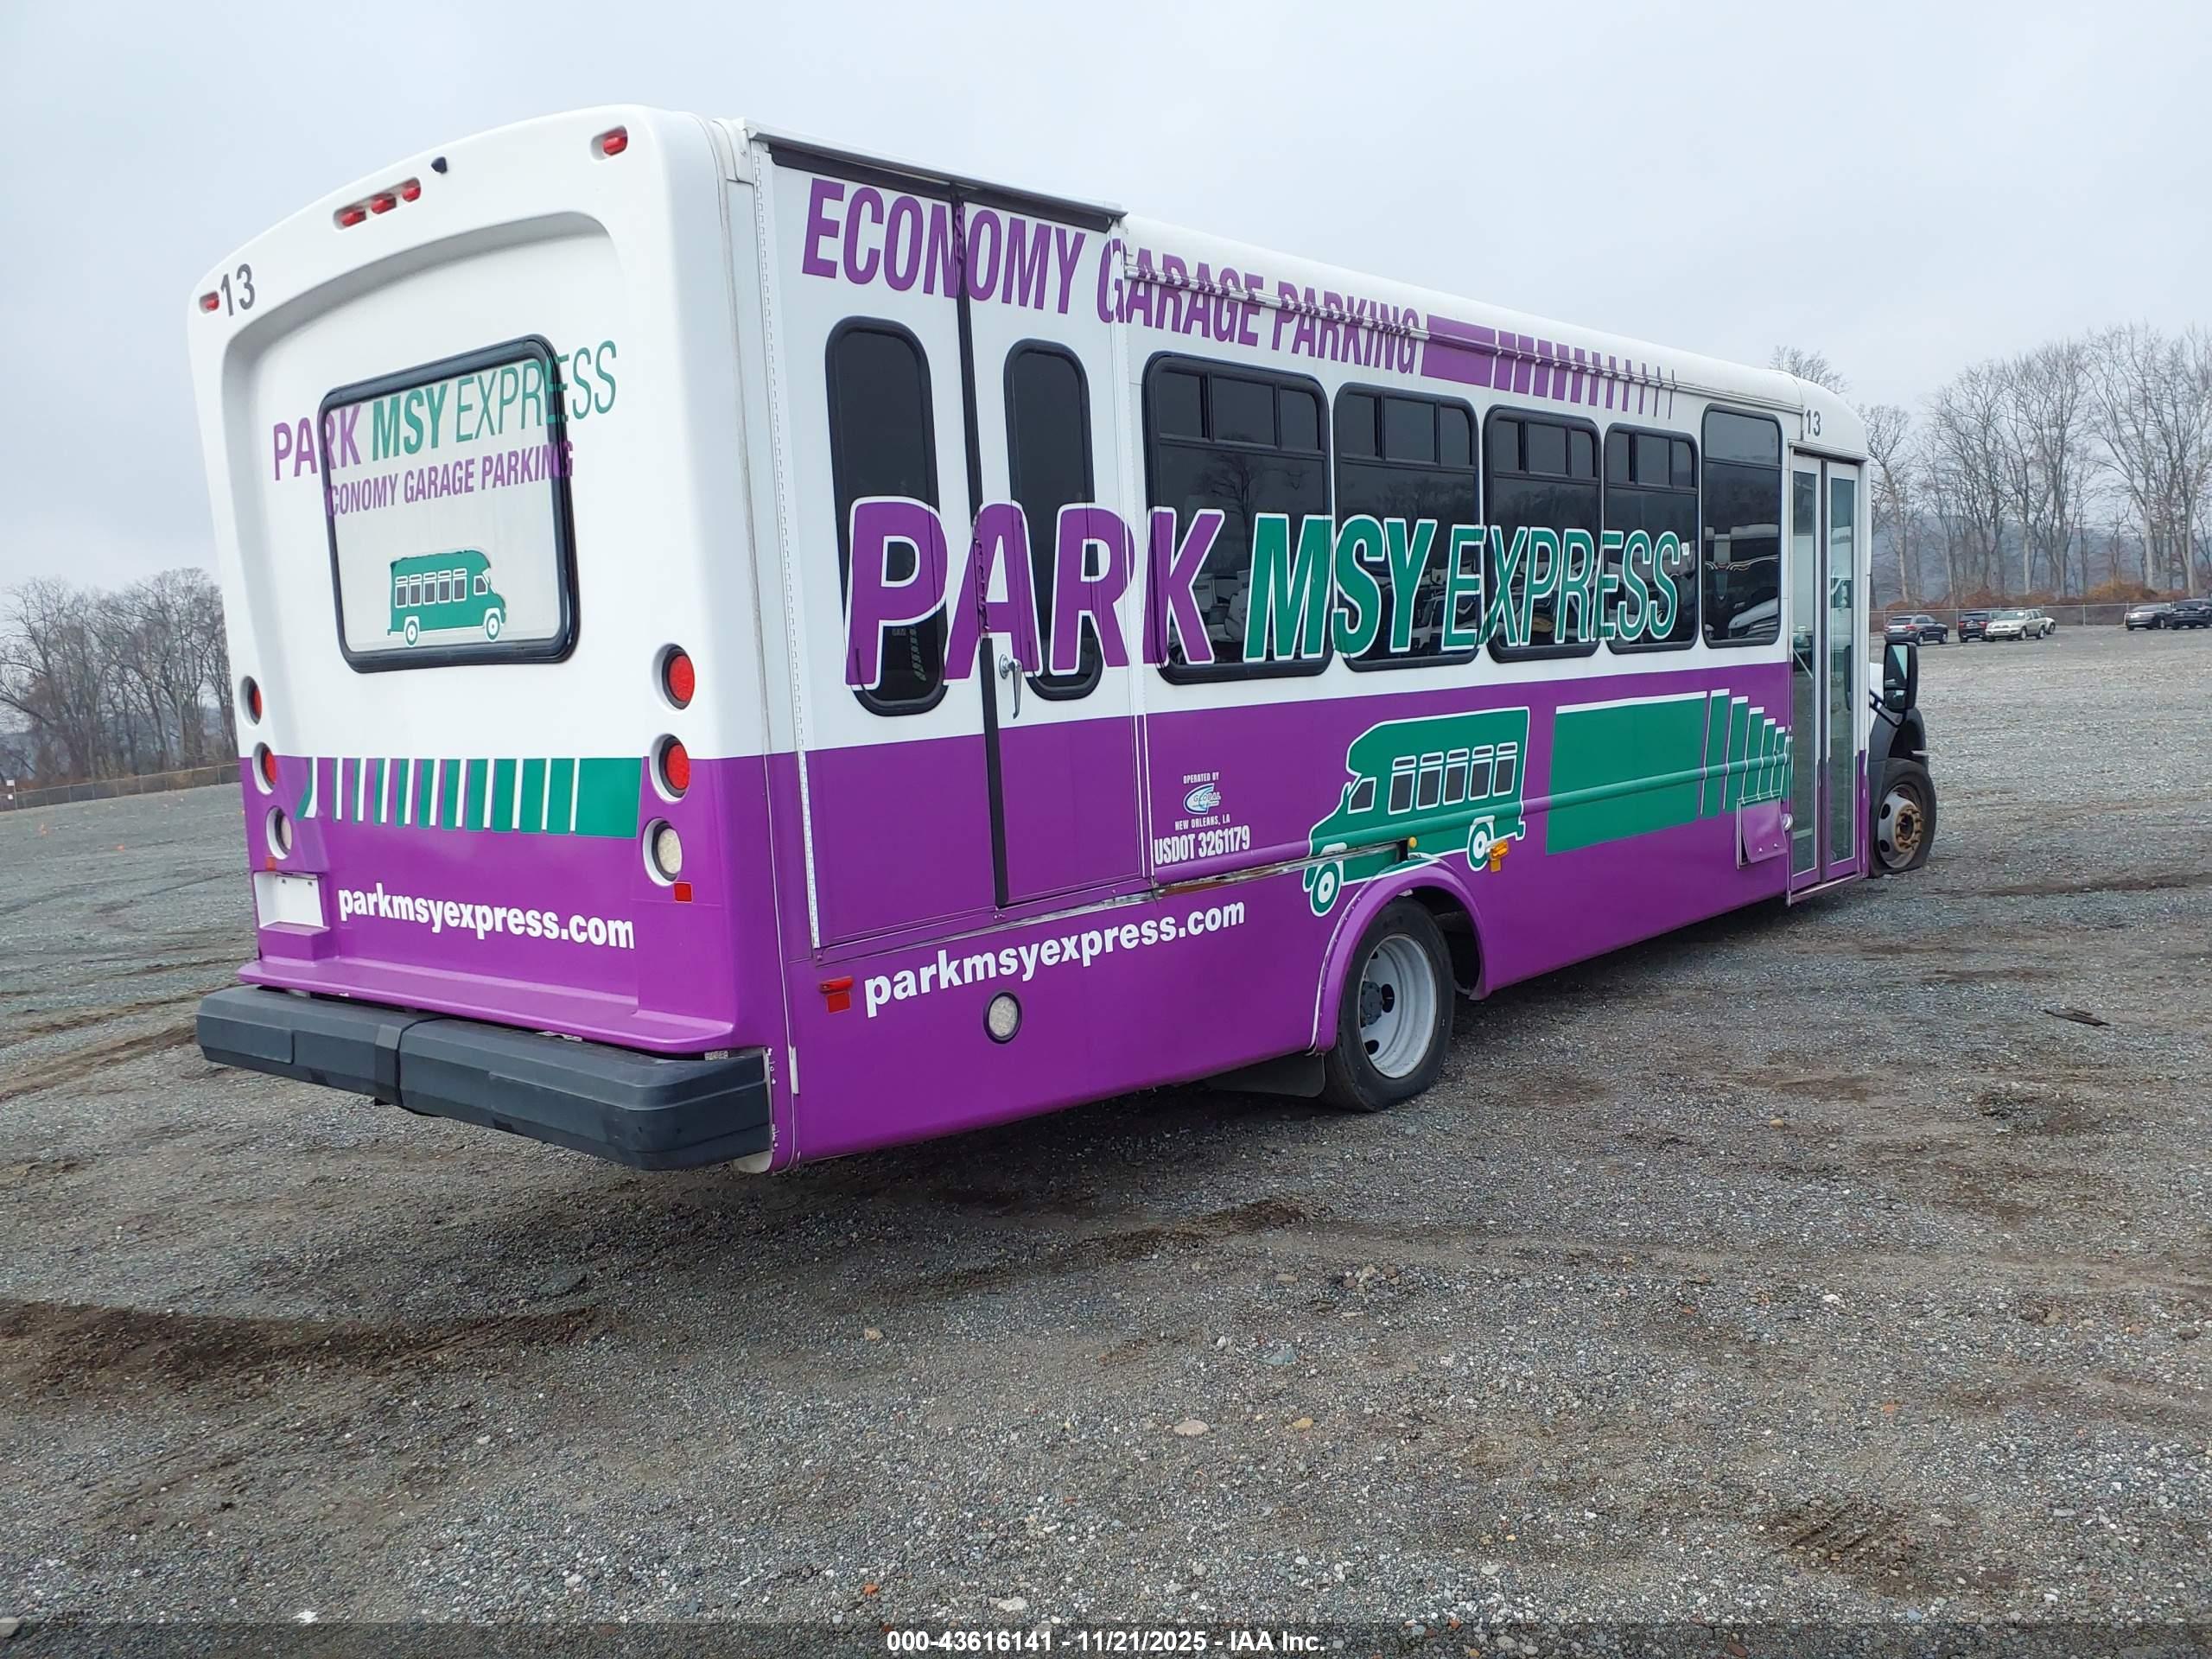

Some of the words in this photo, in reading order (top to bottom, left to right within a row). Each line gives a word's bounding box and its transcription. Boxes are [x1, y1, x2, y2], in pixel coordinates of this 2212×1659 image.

[220, 264, 256, 316] 13
[802, 178, 1086, 315] ECONOMY
[1097, 238, 1264, 347] GARAGE
[1272, 280, 1420, 374] PARKING
[273, 404, 361, 480] PARK
[372, 383, 448, 461] MSY
[456, 340, 617, 442] EXPRESS
[1806, 409, 1821, 436] 13
[404, 458, 475, 503] GARAGE
[481, 439, 574, 490] PARKING
[843, 496, 1225, 690] PARK
[1243, 512, 1438, 660] MSY
[1440, 524, 1681, 652] EXPRESS
[1183, 772, 1211, 785] OPERATED
[1154, 834, 1196, 865] USDOT
[1198, 825, 1250, 858] 3261179
[1174, 820, 1189, 831] NEW
[1222, 813, 1230, 824] LA
[338, 882, 635, 950] parkmsyexpress.com
[864, 901, 1246, 1018] parkmsyexpress.com
